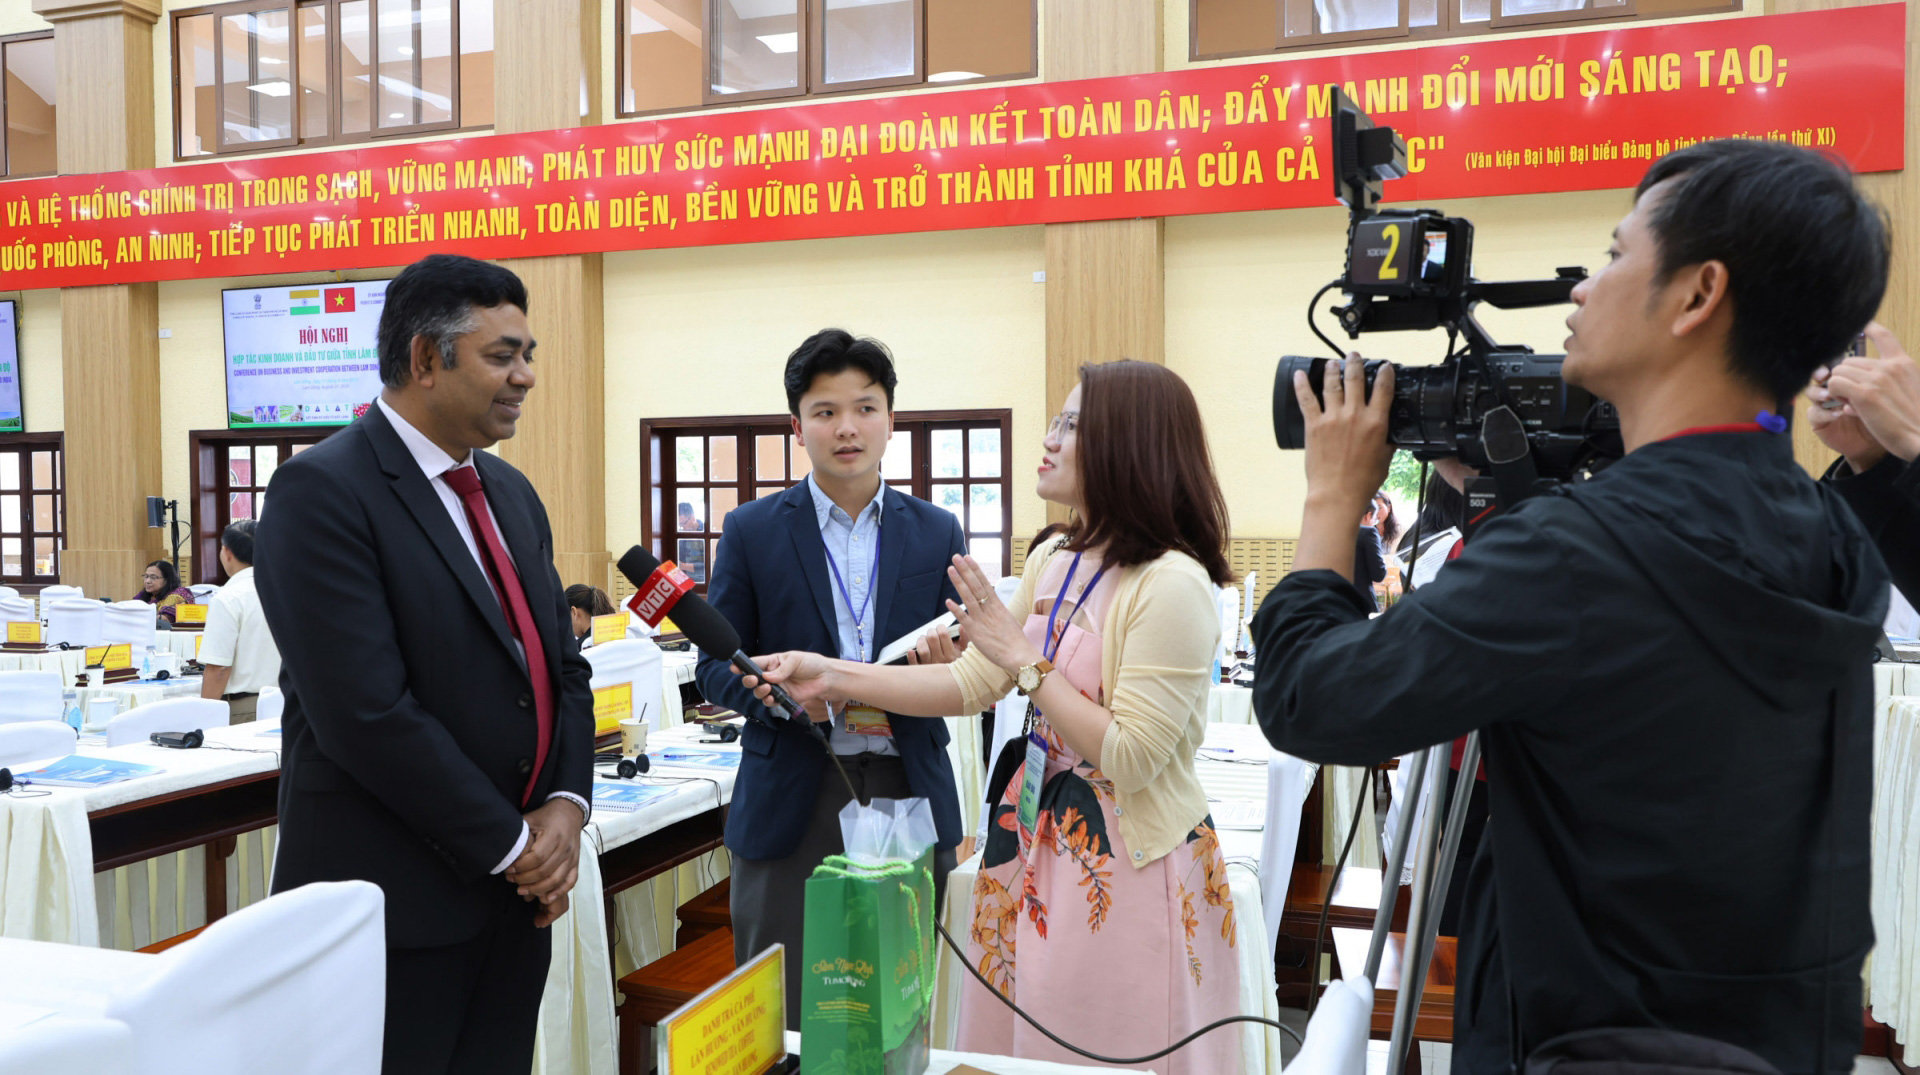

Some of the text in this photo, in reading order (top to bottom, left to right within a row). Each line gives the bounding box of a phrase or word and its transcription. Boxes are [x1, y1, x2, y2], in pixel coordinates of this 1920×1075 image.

[6, 194, 32, 227] VÀ
[38, 191, 62, 229] HỆ
[67, 185, 132, 222] THỐNG
[139, 182, 197, 217] CHÍNH
[202, 181, 234, 214] TRỊ
[241, 175, 309, 208] TRONG
[315, 169, 381, 206] SẠCH,
[387, 159, 447, 196] VỮNG
[454, 155, 535, 193] MẠNH;
[542, 143, 606, 183] PHÁT
[615, 142, 665, 177] HUY
[674, 131, 724, 171] SỨC
[733, 129, 811, 171] MẠNH
[820, 123, 869, 163] ĐẠI
[879, 111, 959, 155] ĐOÀN
[969, 101, 1028, 147] KẾT
[1038, 96, 1123, 140] TOÀN
[1134, 89, 1212, 133] DÂN;
[1223, 74, 1292, 125] ĐẨY
[1420, 55, 1481, 111] ĐỔI
[1495, 54, 1565, 105] MỚI
[1579, 49, 1681, 97] SÁNG
[1694, 43, 1789, 95] TẠO;
[1465, 151, 1493, 172] (Văn
[1495, 149, 1521, 170] kiện
[1523, 147, 1544, 169] Đại
[1546, 145, 1565, 167] hội
[1569, 144, 1589, 165] Đại
[1592, 139, 1618, 161] biểu
[1621, 139, 1652, 161] Đảng
[1791, 127, 1813, 147] thứ
[1817, 126, 1836, 147] XI)
[0, 236, 37, 272] UỐC
[42, 234, 109, 270] PHÒNG,
[115, 235, 143, 264] AN
[149, 231, 202, 264] NINH;
[208, 220, 256, 257] TIẾP
[261, 223, 302, 259] TỤC
[309, 214, 362, 251] PHÁT
[371, 204, 435, 245] TRIỂN
[443, 205, 528, 241] NHANH,
[534, 195, 601, 233] TOÀN
[609, 189, 678, 233] DIỆN,
[685, 181, 738, 223] BỀN
[746, 179, 819, 219] VỮNG
[826, 173, 865, 213] VÀ
[872, 163, 929, 210] TRỞ
[936, 163, 1035, 206] THÀNH
[1044, 153, 1113, 199] TỈNH
[1124, 147, 1187, 193] KHÁ
[1197, 141, 1265, 188] CỦA
[1276, 135, 1320, 183] CẢ
[1378, 223, 1400, 280] 2
[299, 325, 348, 347] HỘI NGHỊ
[1469, 498, 1486, 507] 503
[638, 579, 674, 619] VTC
